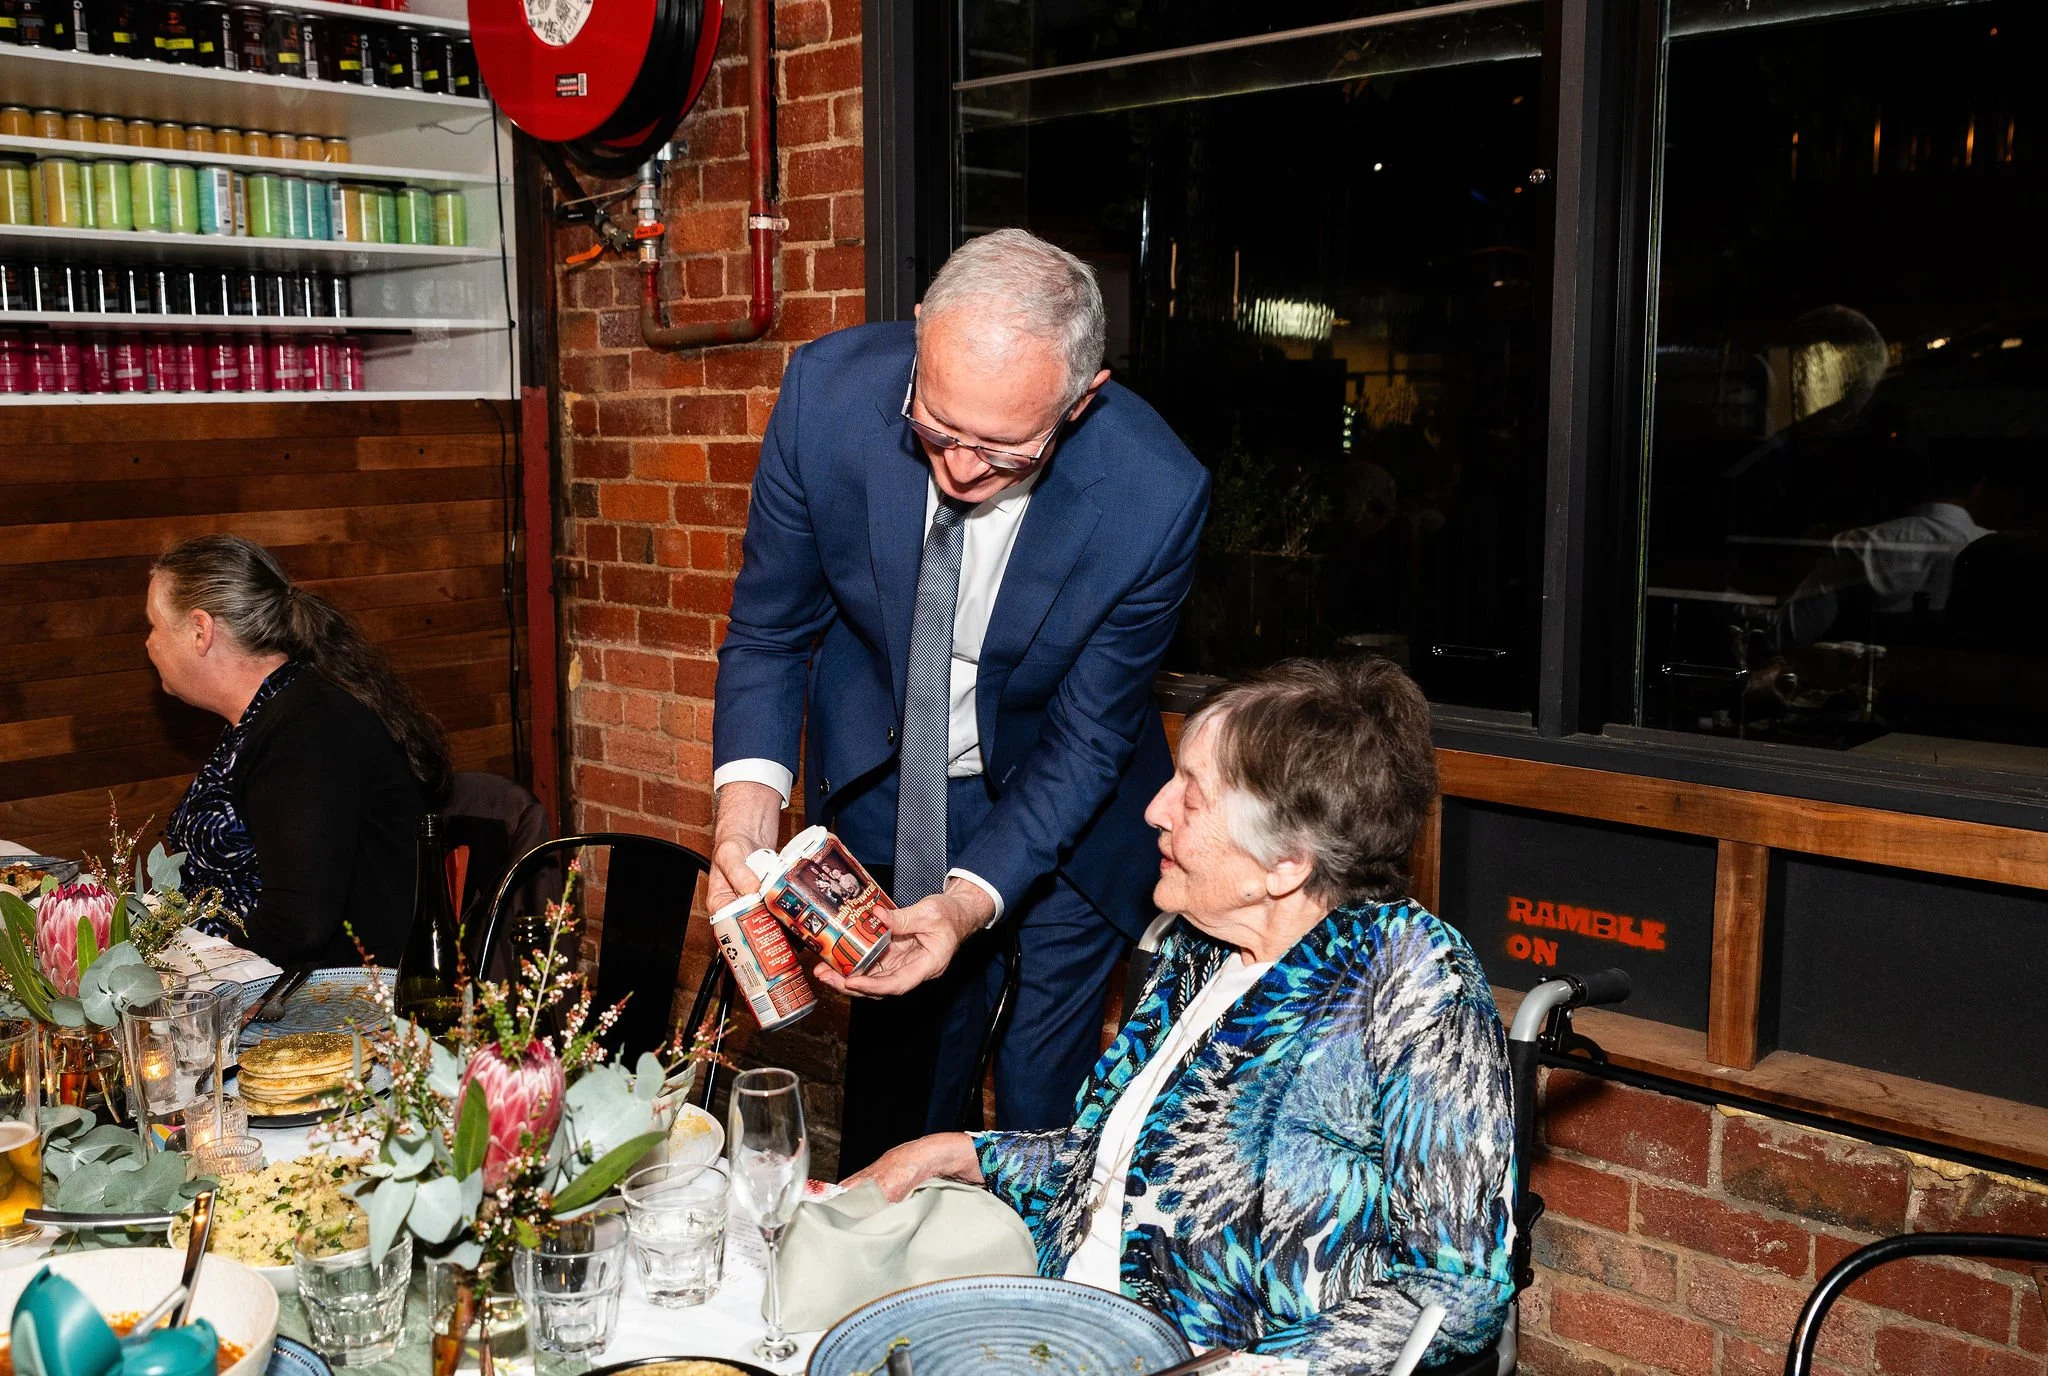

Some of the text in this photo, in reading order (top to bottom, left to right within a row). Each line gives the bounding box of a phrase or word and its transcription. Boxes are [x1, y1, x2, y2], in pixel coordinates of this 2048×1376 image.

[833, 903, 853, 929] amily
[1508, 896, 1665, 950] RAMBLE
[1507, 934, 1558, 967] ON
